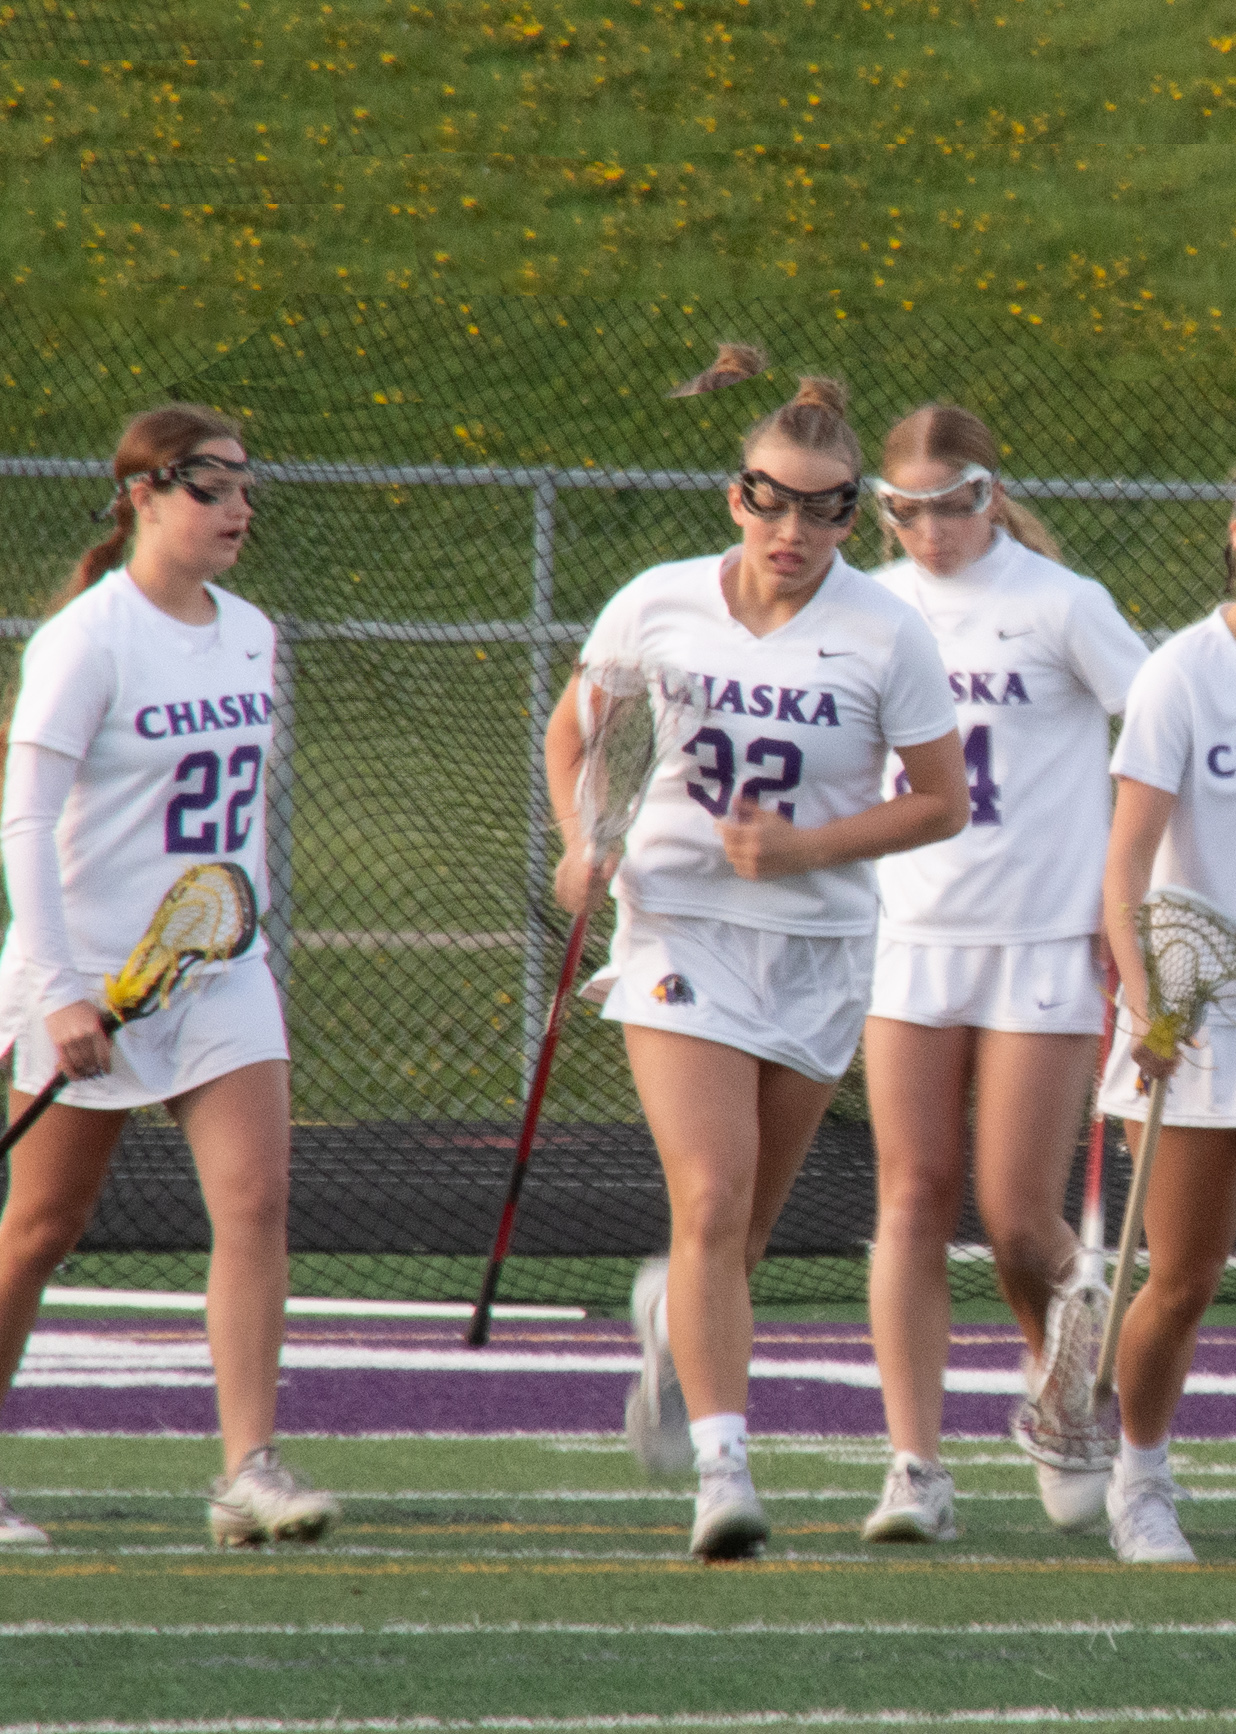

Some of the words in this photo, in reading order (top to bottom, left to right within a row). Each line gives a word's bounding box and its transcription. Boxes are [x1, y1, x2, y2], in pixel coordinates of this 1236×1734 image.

[948, 671, 1033, 706] SKA
[165, 744, 263, 854] 22
[682, 726, 803, 823] 32
